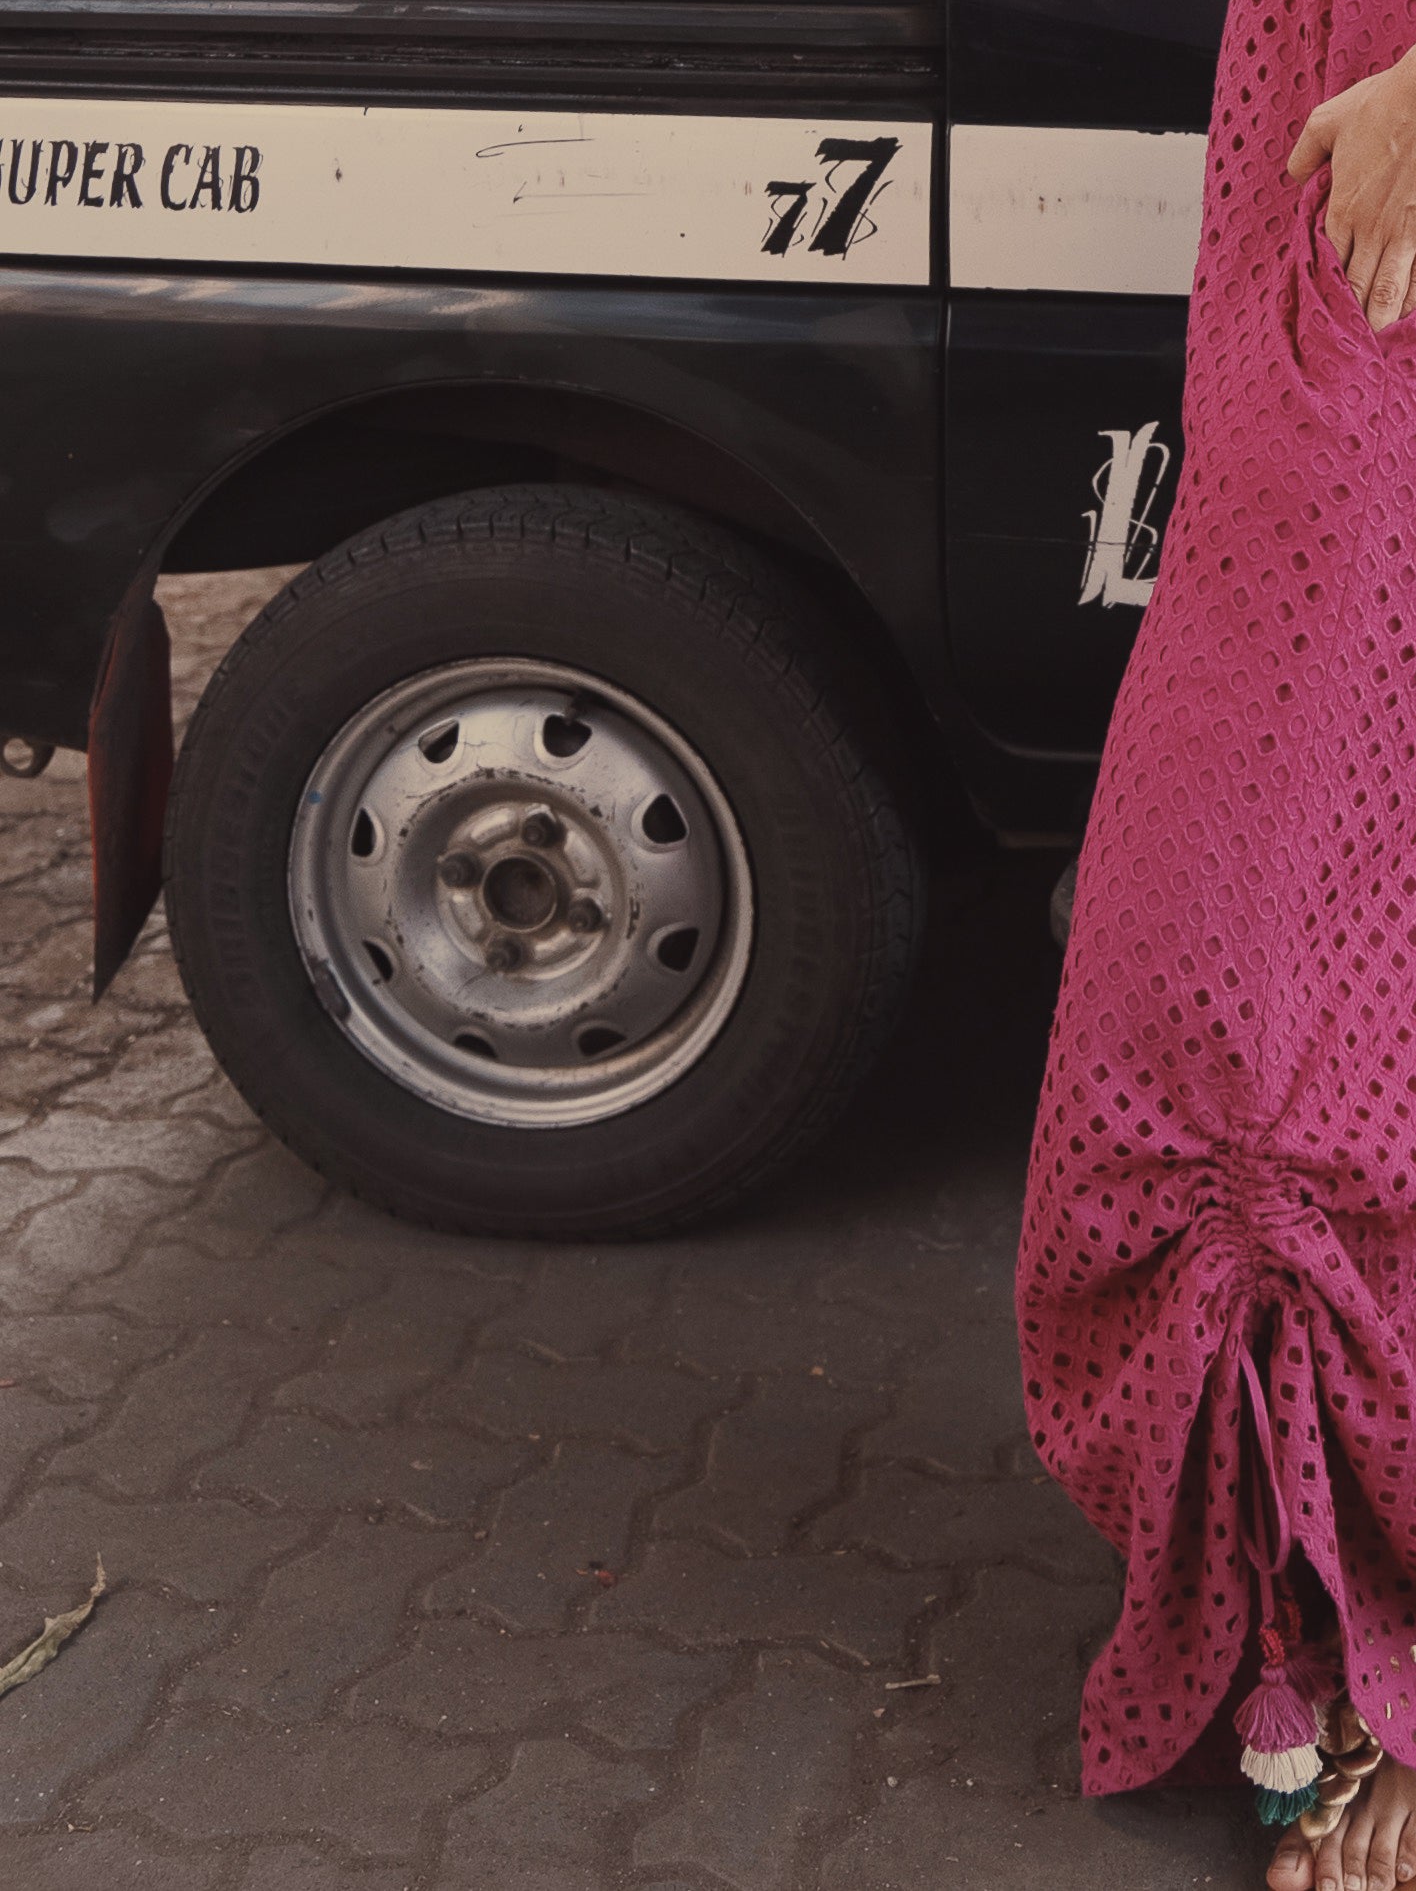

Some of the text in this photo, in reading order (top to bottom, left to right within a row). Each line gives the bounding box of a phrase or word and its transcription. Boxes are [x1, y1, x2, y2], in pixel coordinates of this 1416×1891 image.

[0, 138, 264, 214] UPER CAB
[760, 136, 904, 261] 77
